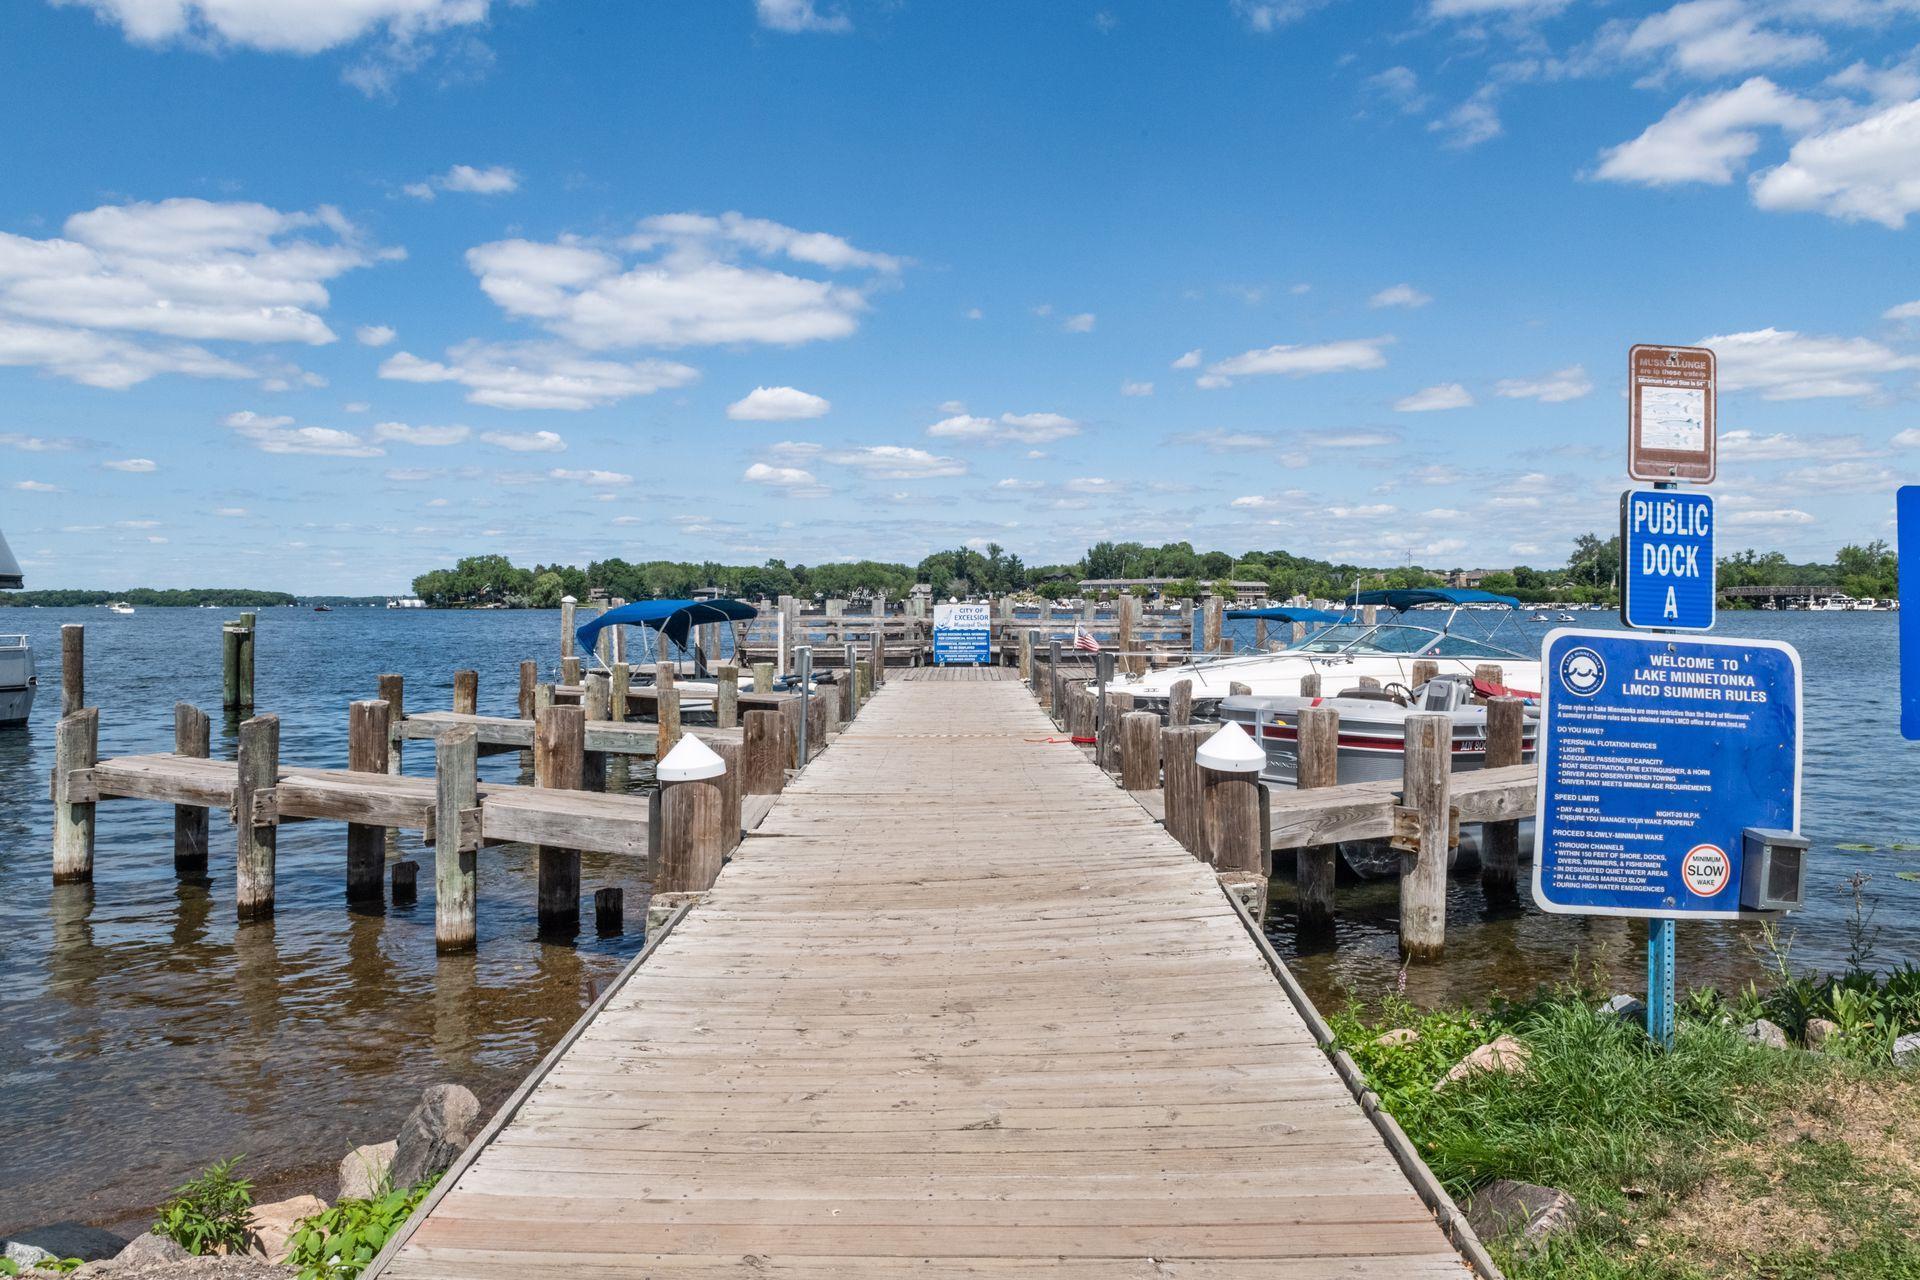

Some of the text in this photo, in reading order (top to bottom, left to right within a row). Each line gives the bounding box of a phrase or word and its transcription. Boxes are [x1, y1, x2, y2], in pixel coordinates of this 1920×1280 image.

[1640, 359, 1706, 369] MUSKELLUNGE
[1635, 501, 1708, 536] PUBLIC
[1643, 543, 1699, 577] DOCK
[1664, 586, 1678, 618] A
[1650, 654, 1738, 670] WELCOME TO
[1634, 670, 1755, 686] LAKE MINNETONKA
[1622, 684, 1766, 702] LMCD SUMMER RULES
[1461, 741, 1472, 750] MN
[1665, 783, 1711, 791] REQUIREMENTS
[1688, 865, 1724, 877] SLOW
[1621, 884, 1664, 892] EMERGENCIES
